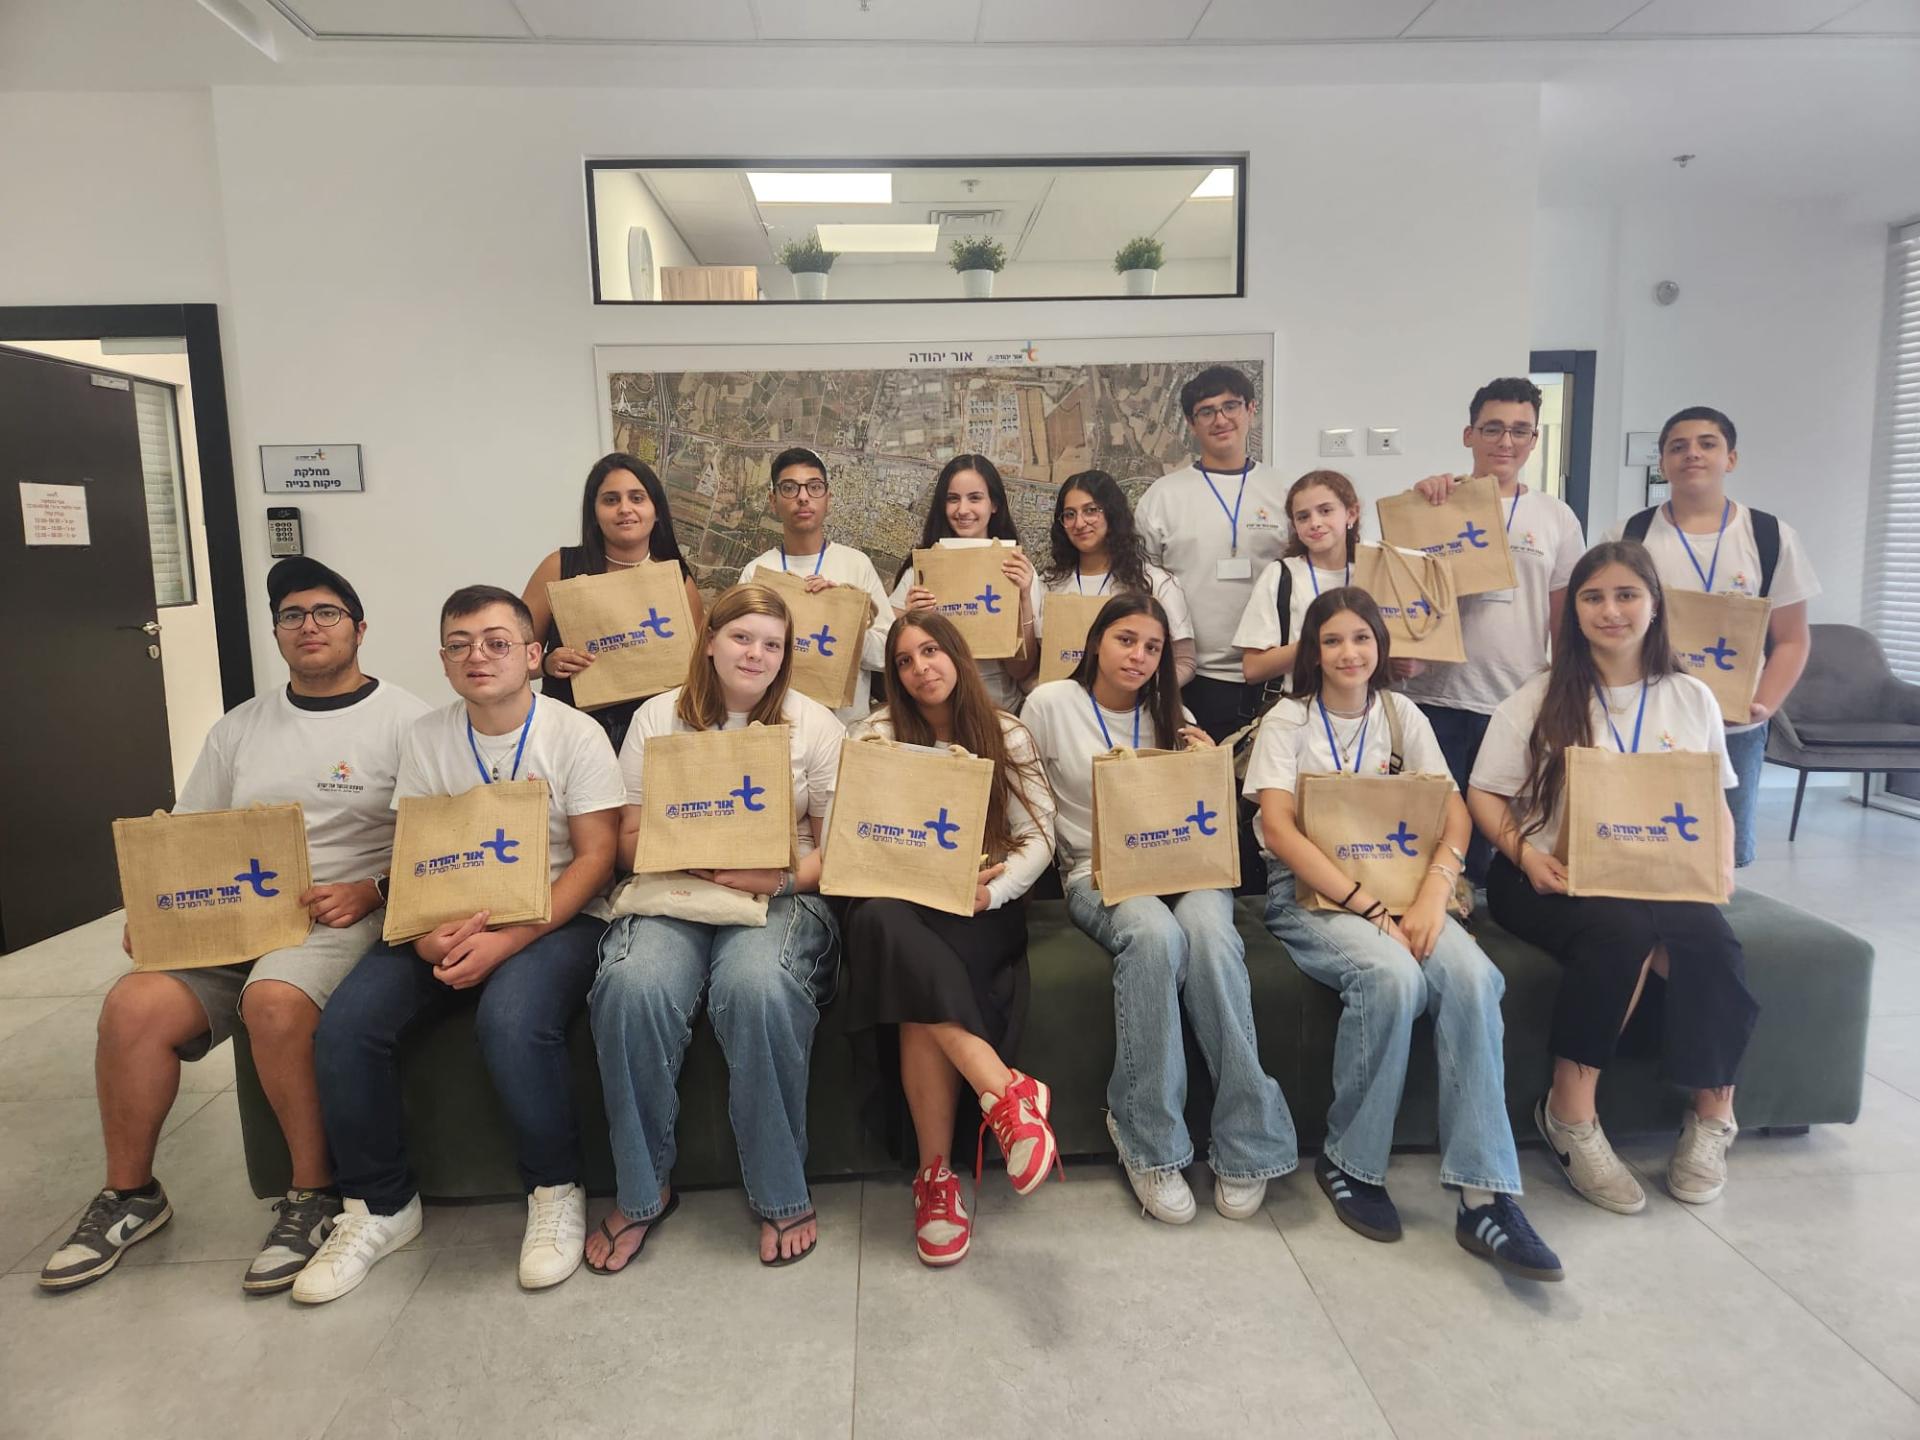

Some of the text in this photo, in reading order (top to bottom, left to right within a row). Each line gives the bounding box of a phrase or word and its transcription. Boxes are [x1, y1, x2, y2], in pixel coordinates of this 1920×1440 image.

[909, 352, 974, 363] אור יהודה
[294, 467, 331, 478] מחלקת
[285, 479, 342, 489] פיקוח בנייה
[943, 602, 979, 613] אור יהודה
[599, 630, 646, 646] אור יהודה
[681, 800, 735, 812] אור יהודה
[872, 824, 928, 840] אור יהודה
[1140, 826, 1190, 842] אור יהודה
[1612, 824, 1668, 835] אור יהודה
[872, 834, 927, 848] המרכז של המרכז
[1350, 843, 1393, 853] אור יהודה
[428, 850, 485, 869] אור יהודה
[428, 860, 485, 876] המרכז של המרכז
[175, 885, 241, 903] אור יהודה
[176, 896, 242, 910] המרכז של המרכז
